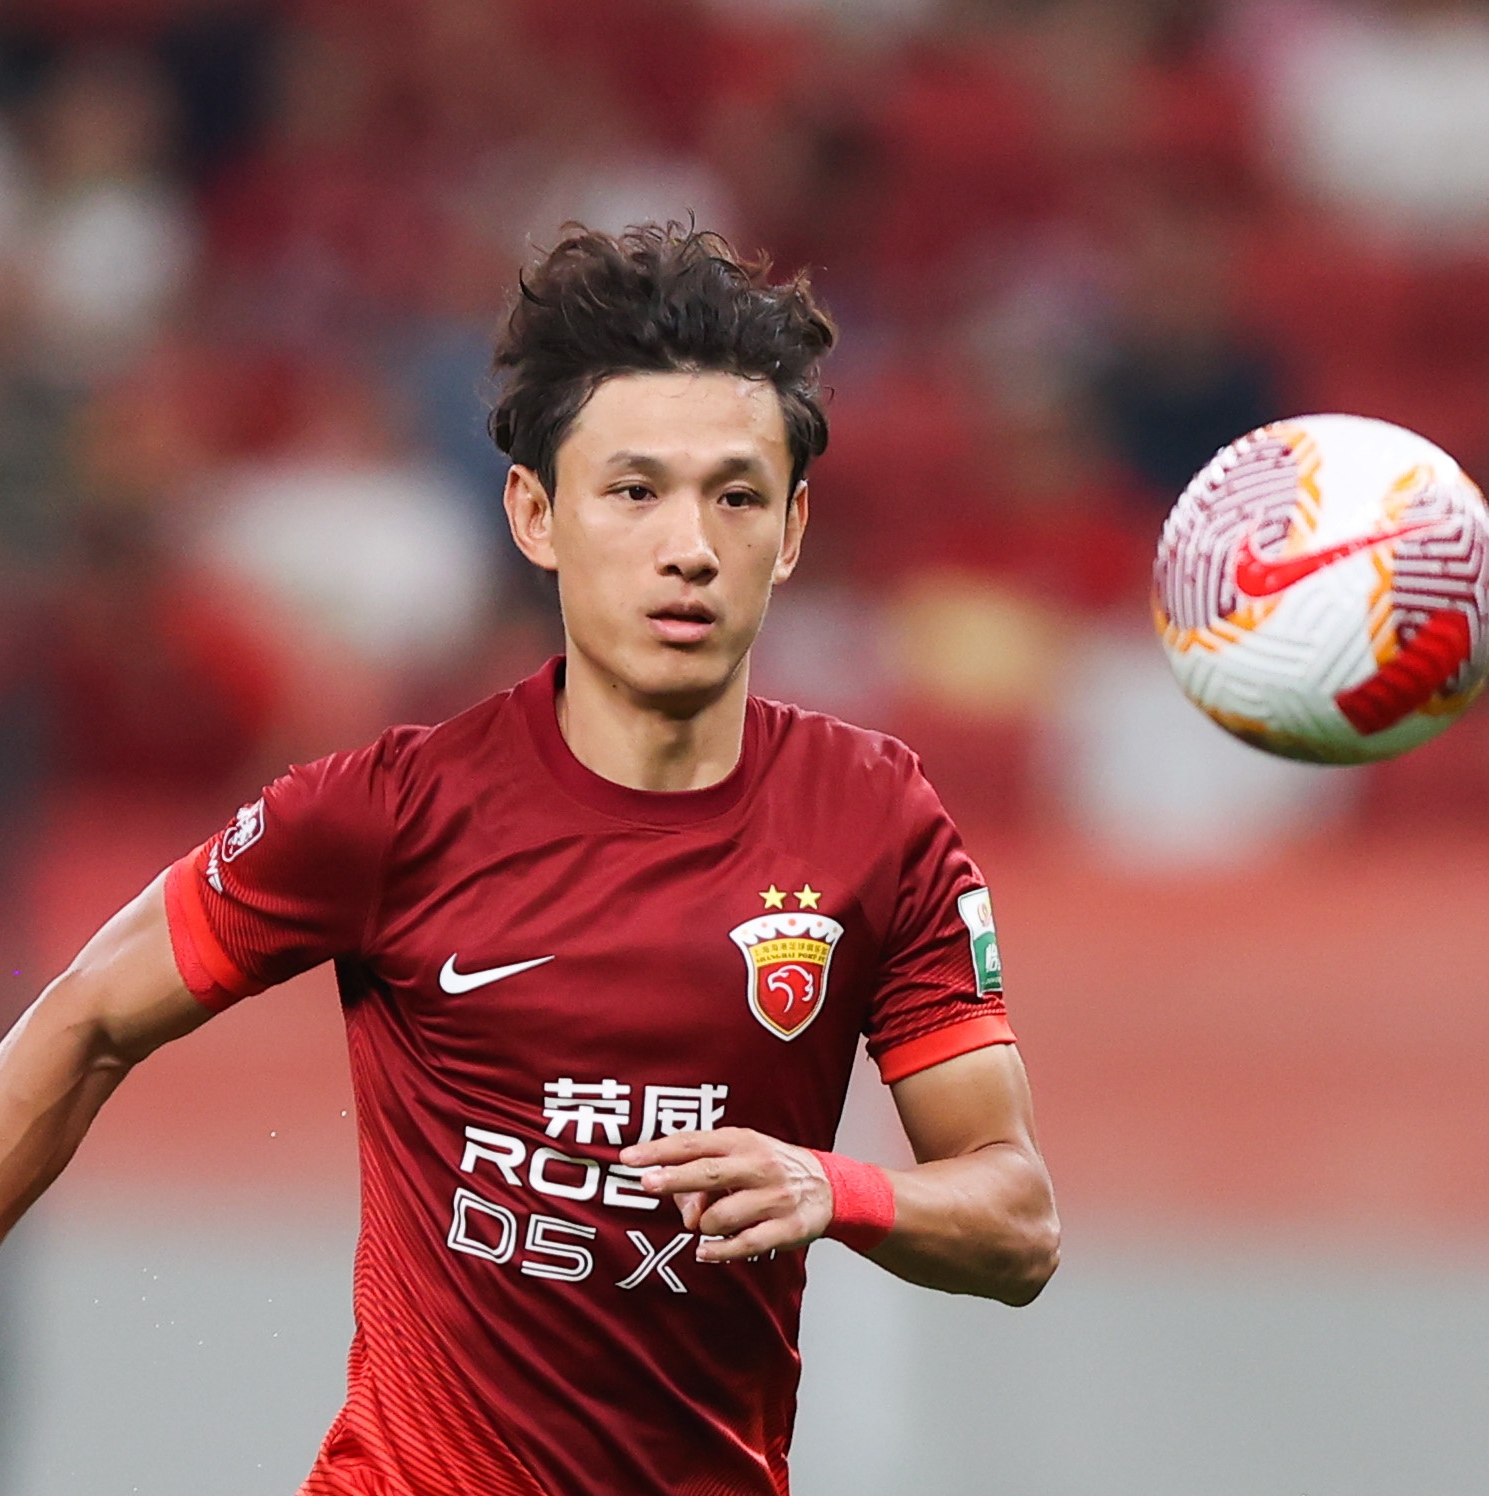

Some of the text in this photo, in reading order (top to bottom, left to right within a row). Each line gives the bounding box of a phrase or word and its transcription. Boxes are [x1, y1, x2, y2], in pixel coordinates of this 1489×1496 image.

[798, 953, 817, 961] PORT
[543, 1077, 729, 1144] 荣威
[459, 1125, 662, 1211] ROE
[446, 1187, 597, 1282] D5
